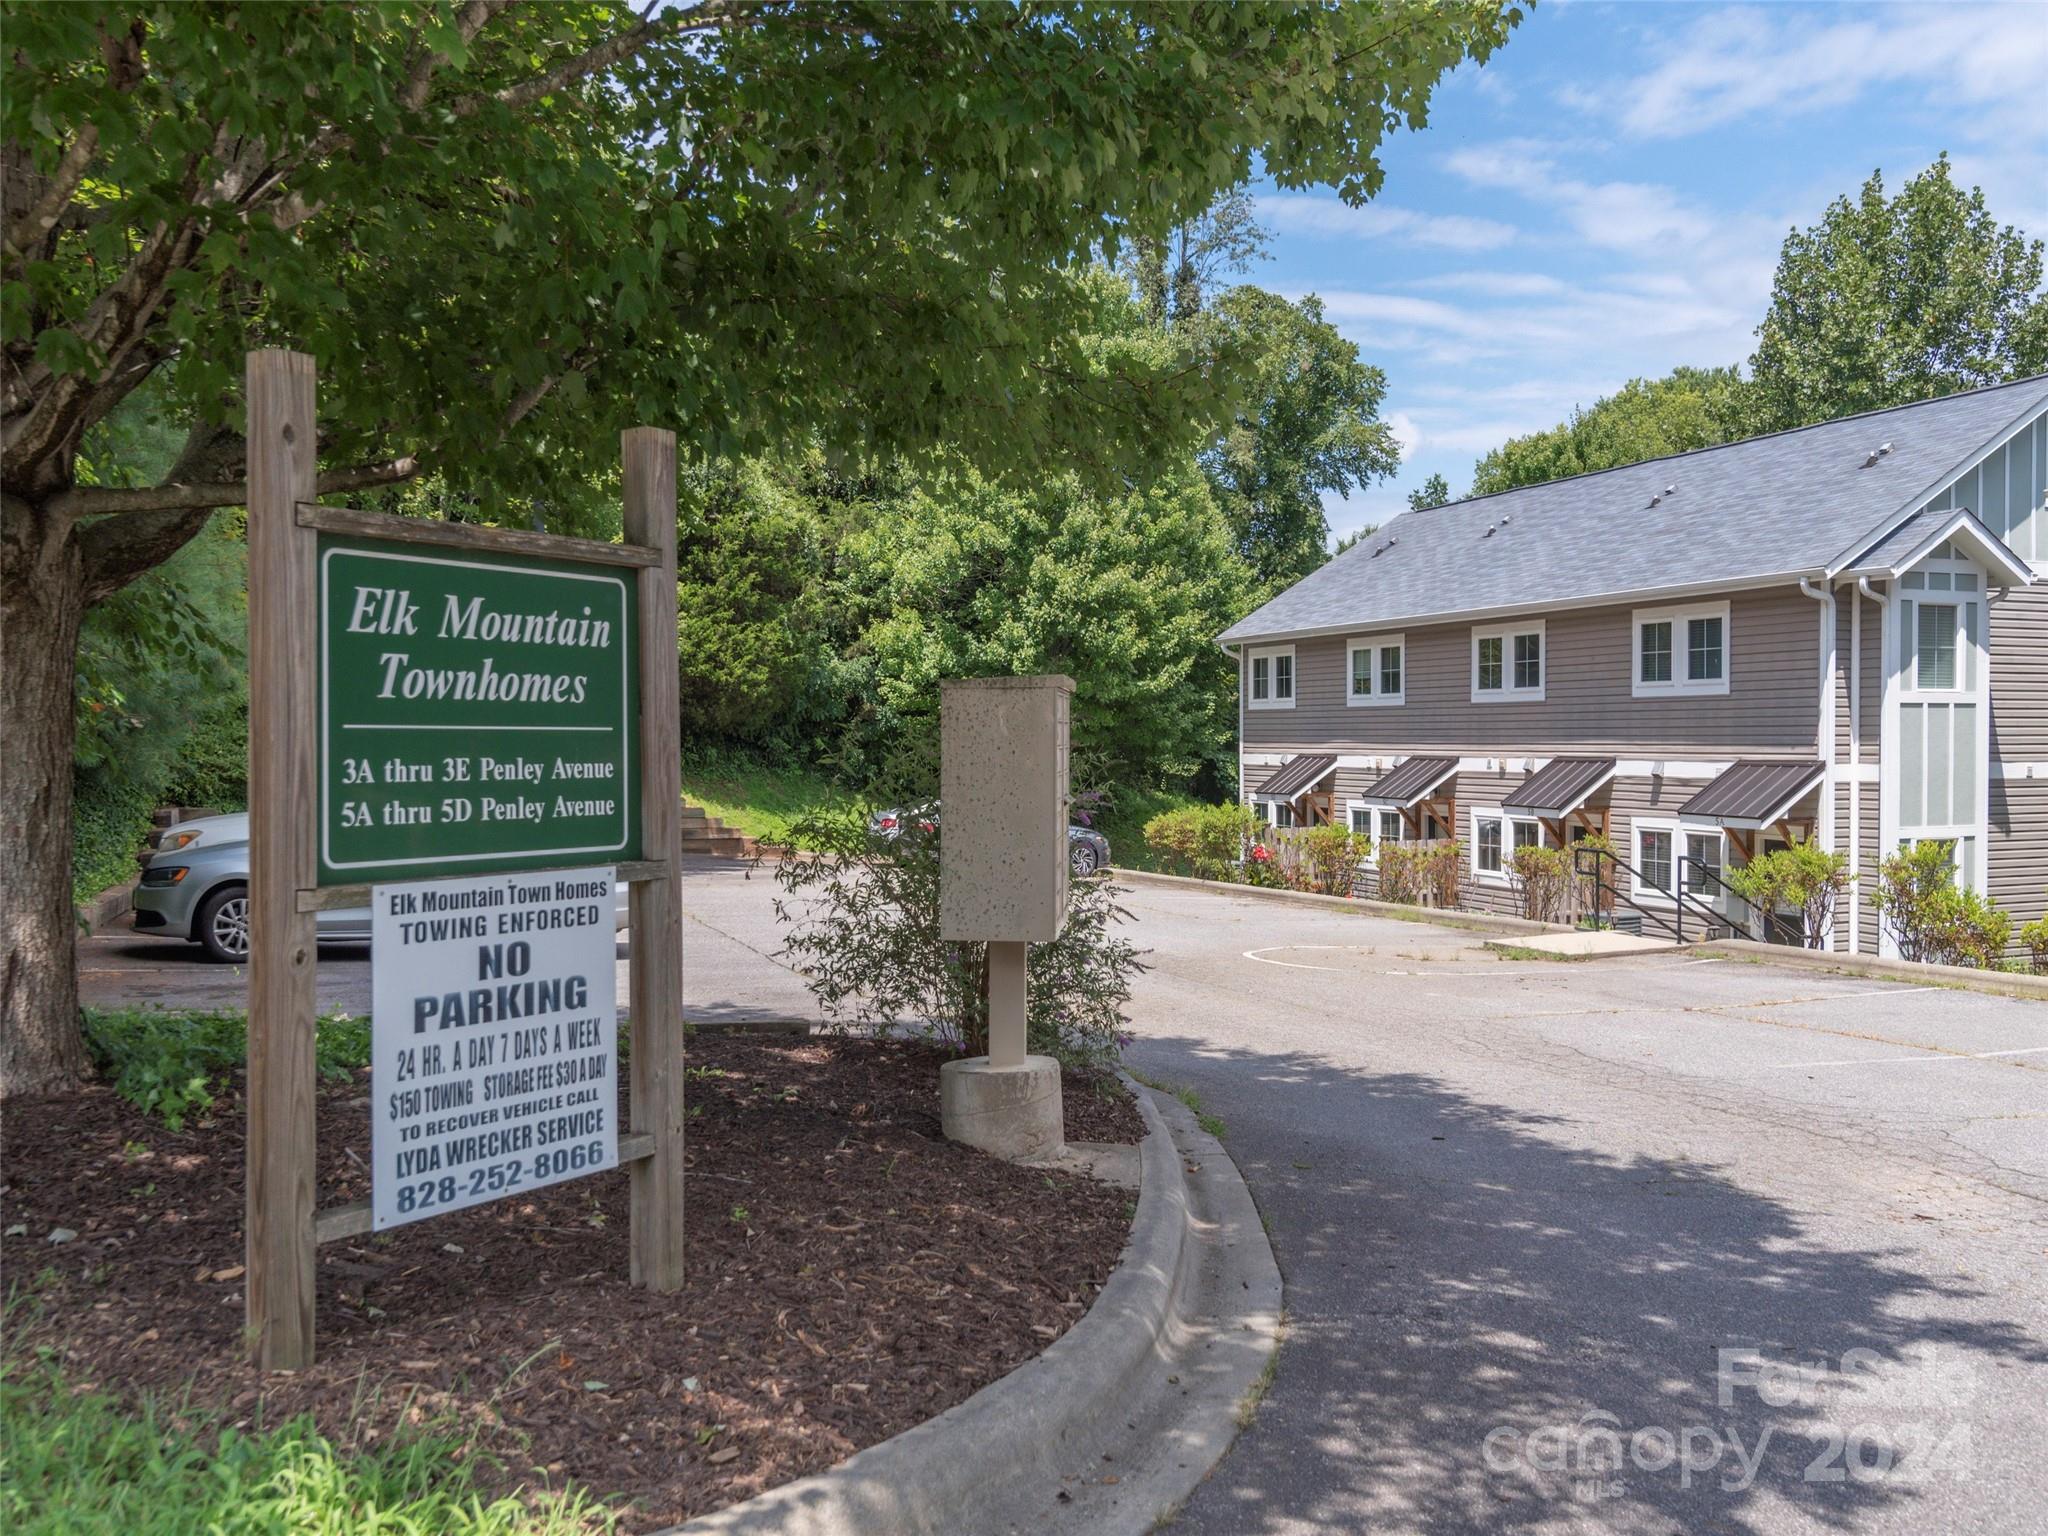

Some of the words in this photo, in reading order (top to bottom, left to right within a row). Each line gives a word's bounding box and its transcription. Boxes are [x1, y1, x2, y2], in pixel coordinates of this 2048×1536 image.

[346, 586, 420, 636] Elk
[437, 594, 611, 648] Mountain
[376, 652, 587, 703] Townhomes
[341, 758, 375, 784] 3A
[384, 758, 433, 783] thru
[442, 757, 471, 781] 3E
[480, 757, 544, 784] Penley
[551, 757, 614, 780] Avenue
[341, 801, 374, 827] 5A
[383, 800, 432, 825] thru
[440, 798, 472, 822] 5D
[480, 797, 545, 823] Penley
[552, 795, 615, 818] Avenue
[390, 892, 417, 916] Elk
[422, 886, 504, 912] Mountain
[508, 884, 551, 905] Town
[555, 880, 608, 900] Homes
[400, 915, 487, 945] TOWING
[498, 905, 599, 934] ENFORCED
[478, 940, 531, 981] NO
[414, 975, 587, 1034] PARKING
[397, 1048, 415, 1082] 24
[422, 1044, 446, 1077] HR.
[453, 1040, 462, 1071] A
[468, 1034, 495, 1068] DAY
[500, 1032, 508, 1063] 7
[514, 1026, 548, 1061] DAYS
[553, 1023, 562, 1053] A
[568, 1017, 601, 1050] WEEK
[389, 1088, 421, 1121] $150
[424, 1078, 474, 1115] TOWING
[484, 1066, 534, 1101] STORAGE
[537, 1062, 554, 1093] FEE
[556, 1057, 577, 1089] $30
[579, 1057, 586, 1082] A
[588, 1053, 607, 1079] DAY
[400, 1125, 421, 1142] TO
[426, 1108, 499, 1137] RECOVER
[503, 1095, 563, 1120] VEHICLE
[566, 1087, 599, 1106] CALL
[396, 1145, 442, 1179] LYDA
[446, 1124, 532, 1167] WRECKER
[537, 1108, 604, 1146] SERVICE
[396, 1140, 604, 1214] 828-252-8066
